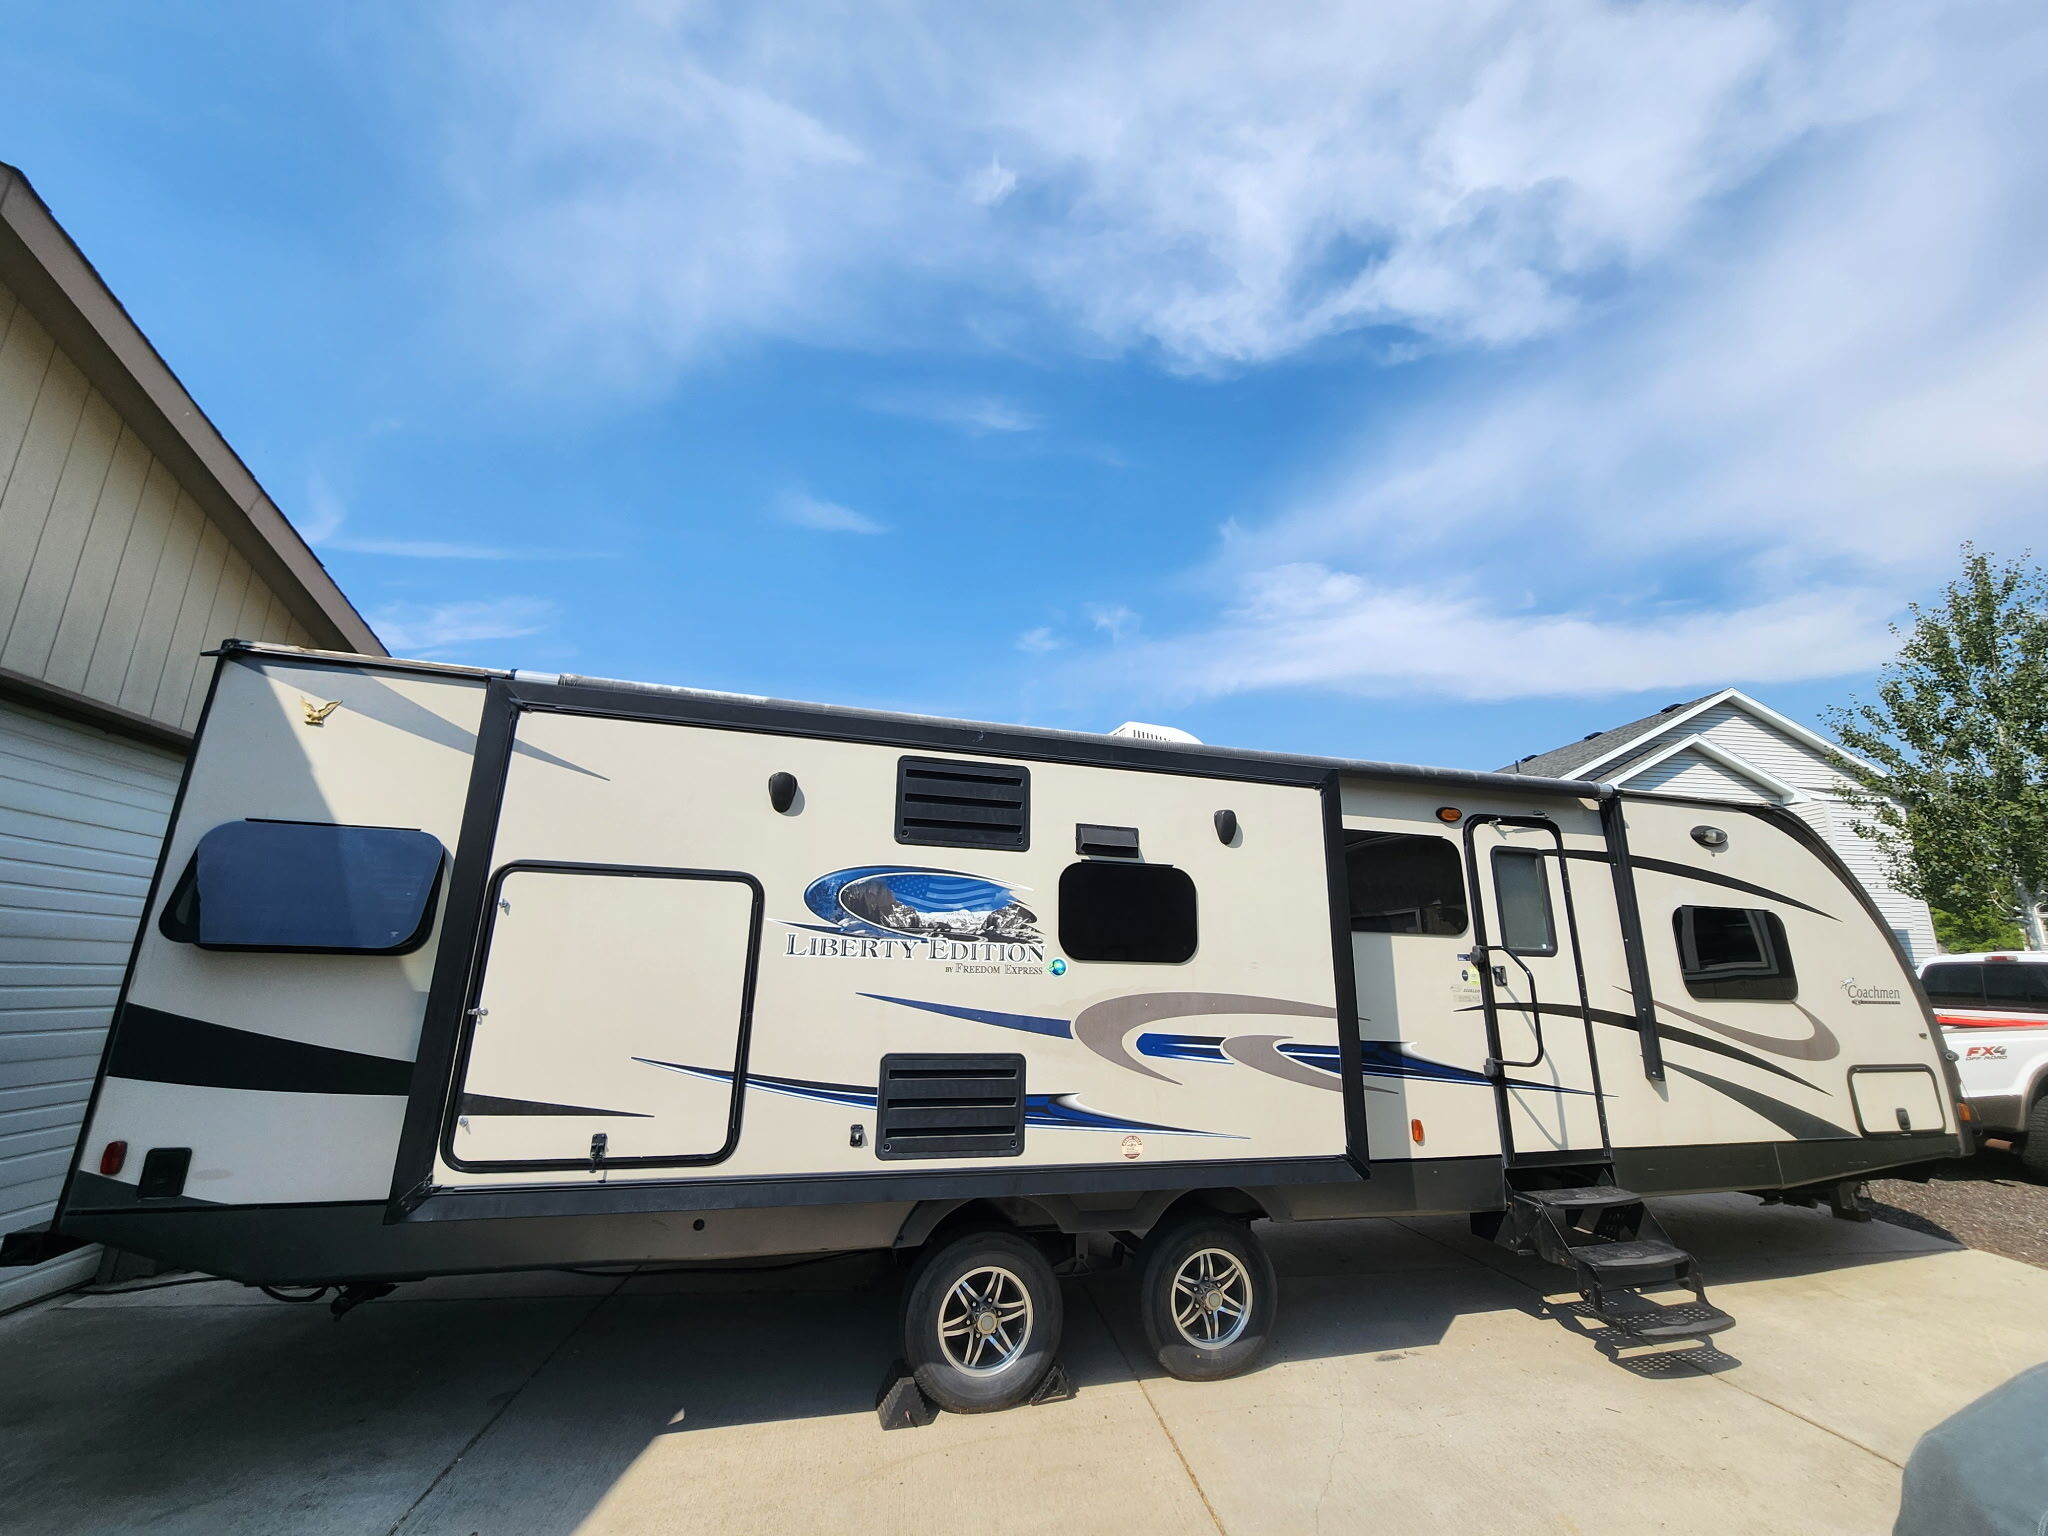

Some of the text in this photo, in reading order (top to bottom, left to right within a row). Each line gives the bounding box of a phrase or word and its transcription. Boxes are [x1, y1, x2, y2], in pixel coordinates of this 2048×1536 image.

[786, 934, 1045, 962] LIBERTY EDITION
[956, 963, 1000, 974] FREEDOM
[1005, 965, 1043, 975] EXPRESS
[1848, 984, 1900, 999] Coachmen
[1966, 1046, 2007, 1056] FX4
